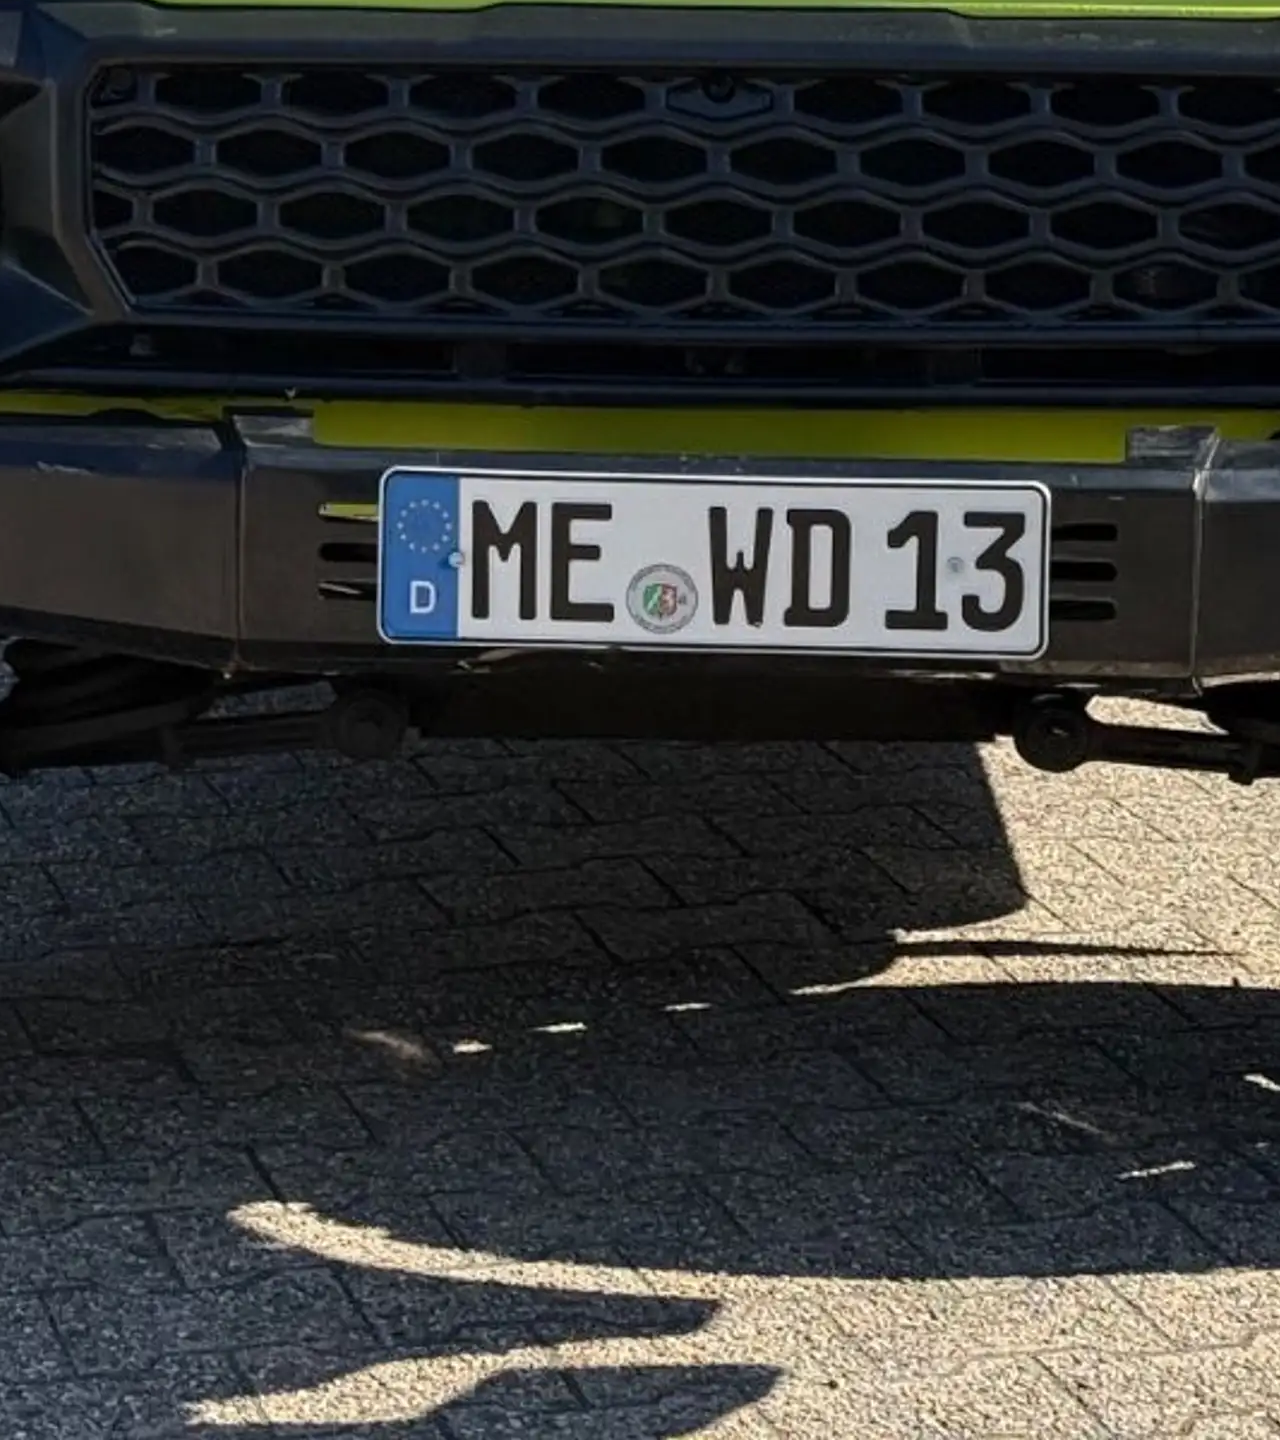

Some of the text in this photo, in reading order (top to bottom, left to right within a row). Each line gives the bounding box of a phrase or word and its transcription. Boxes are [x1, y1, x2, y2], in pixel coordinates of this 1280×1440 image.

[410, 581, 436, 614] D
[470, 500, 615, 622] ME
[708, 506, 853, 628] WD
[884, 510, 1027, 632] 13
